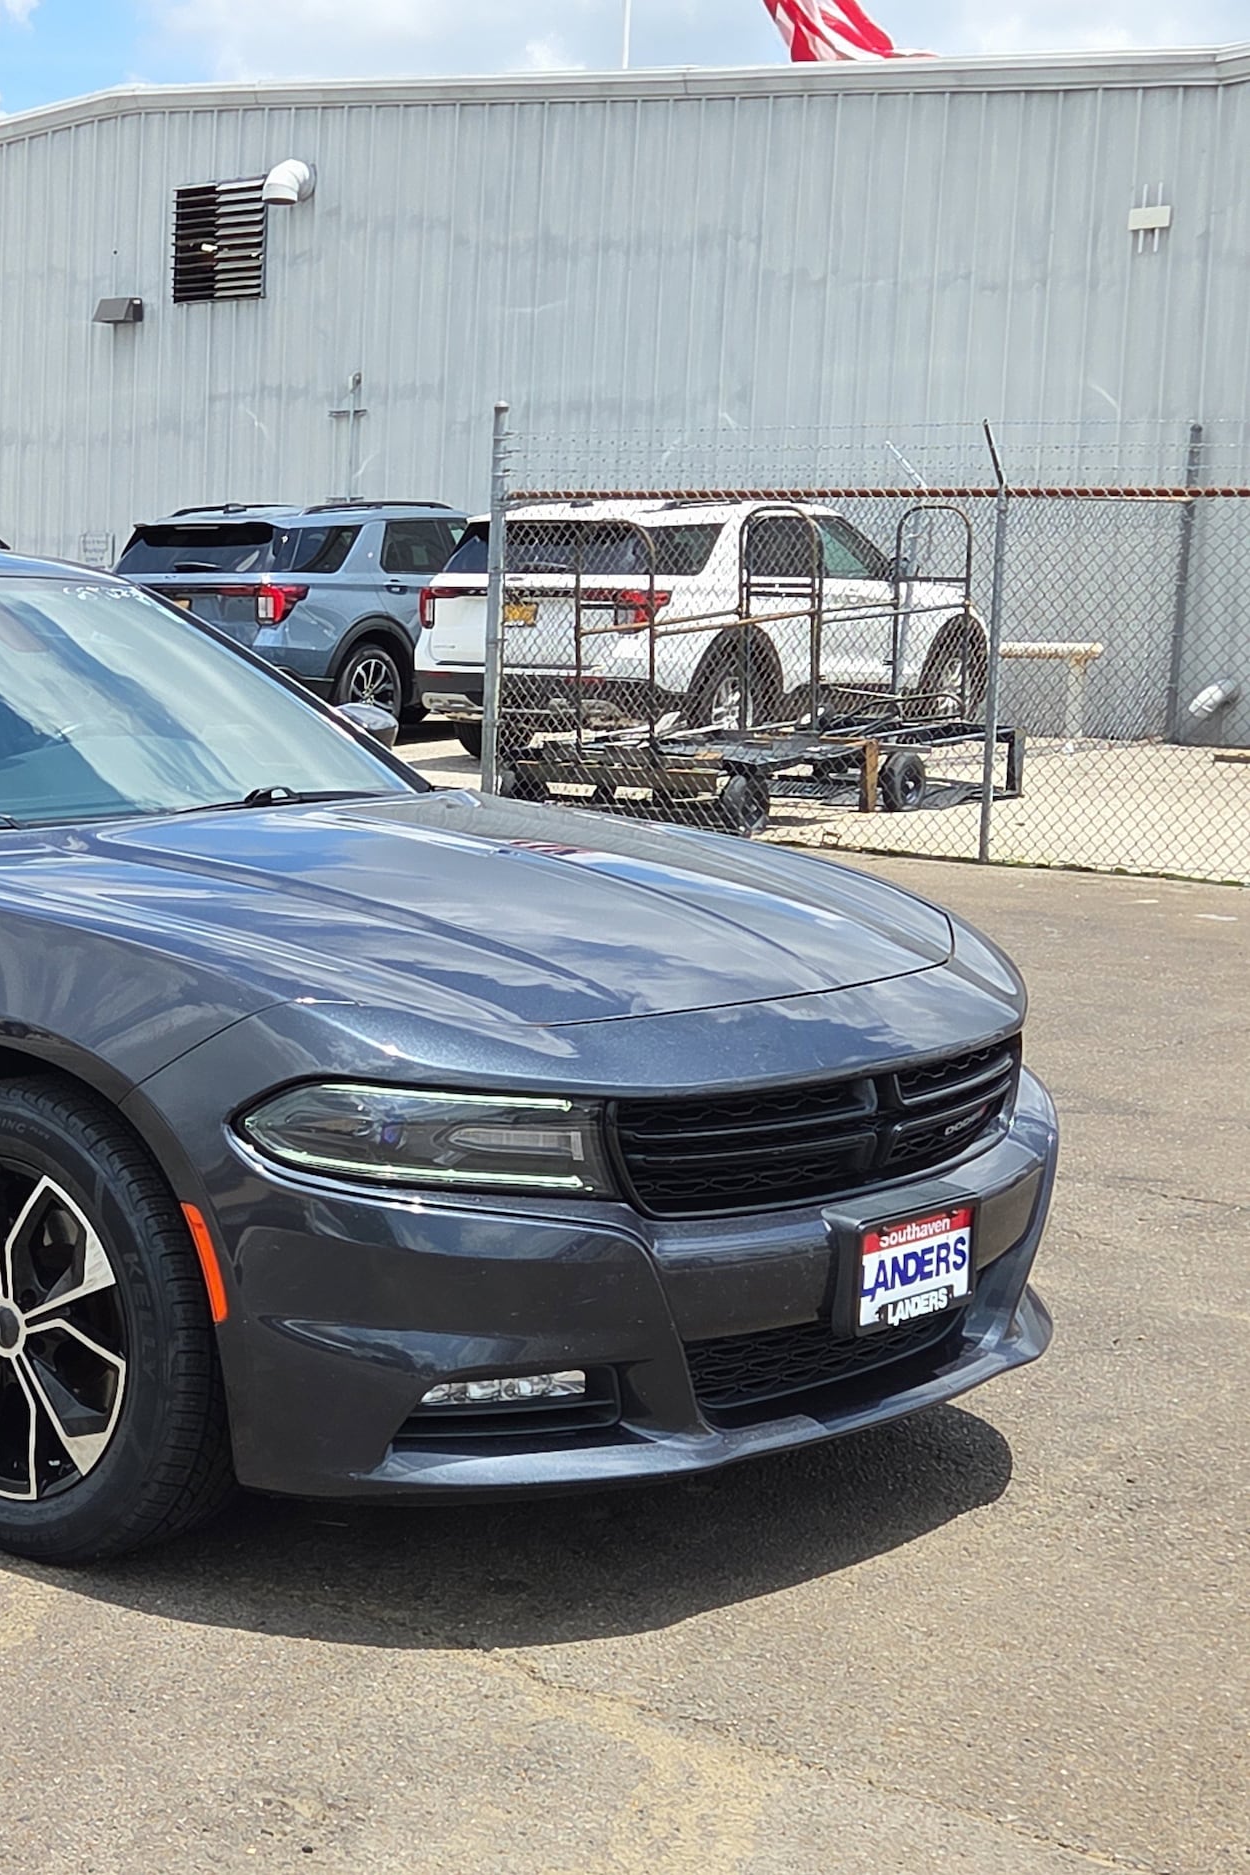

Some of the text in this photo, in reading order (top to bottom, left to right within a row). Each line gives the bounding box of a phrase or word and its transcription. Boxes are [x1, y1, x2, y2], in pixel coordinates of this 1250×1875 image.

[879, 1217, 950, 1248] Southaven
[861, 1236, 967, 1302] LANDERS
[887, 1287, 949, 1327] LANDERS
